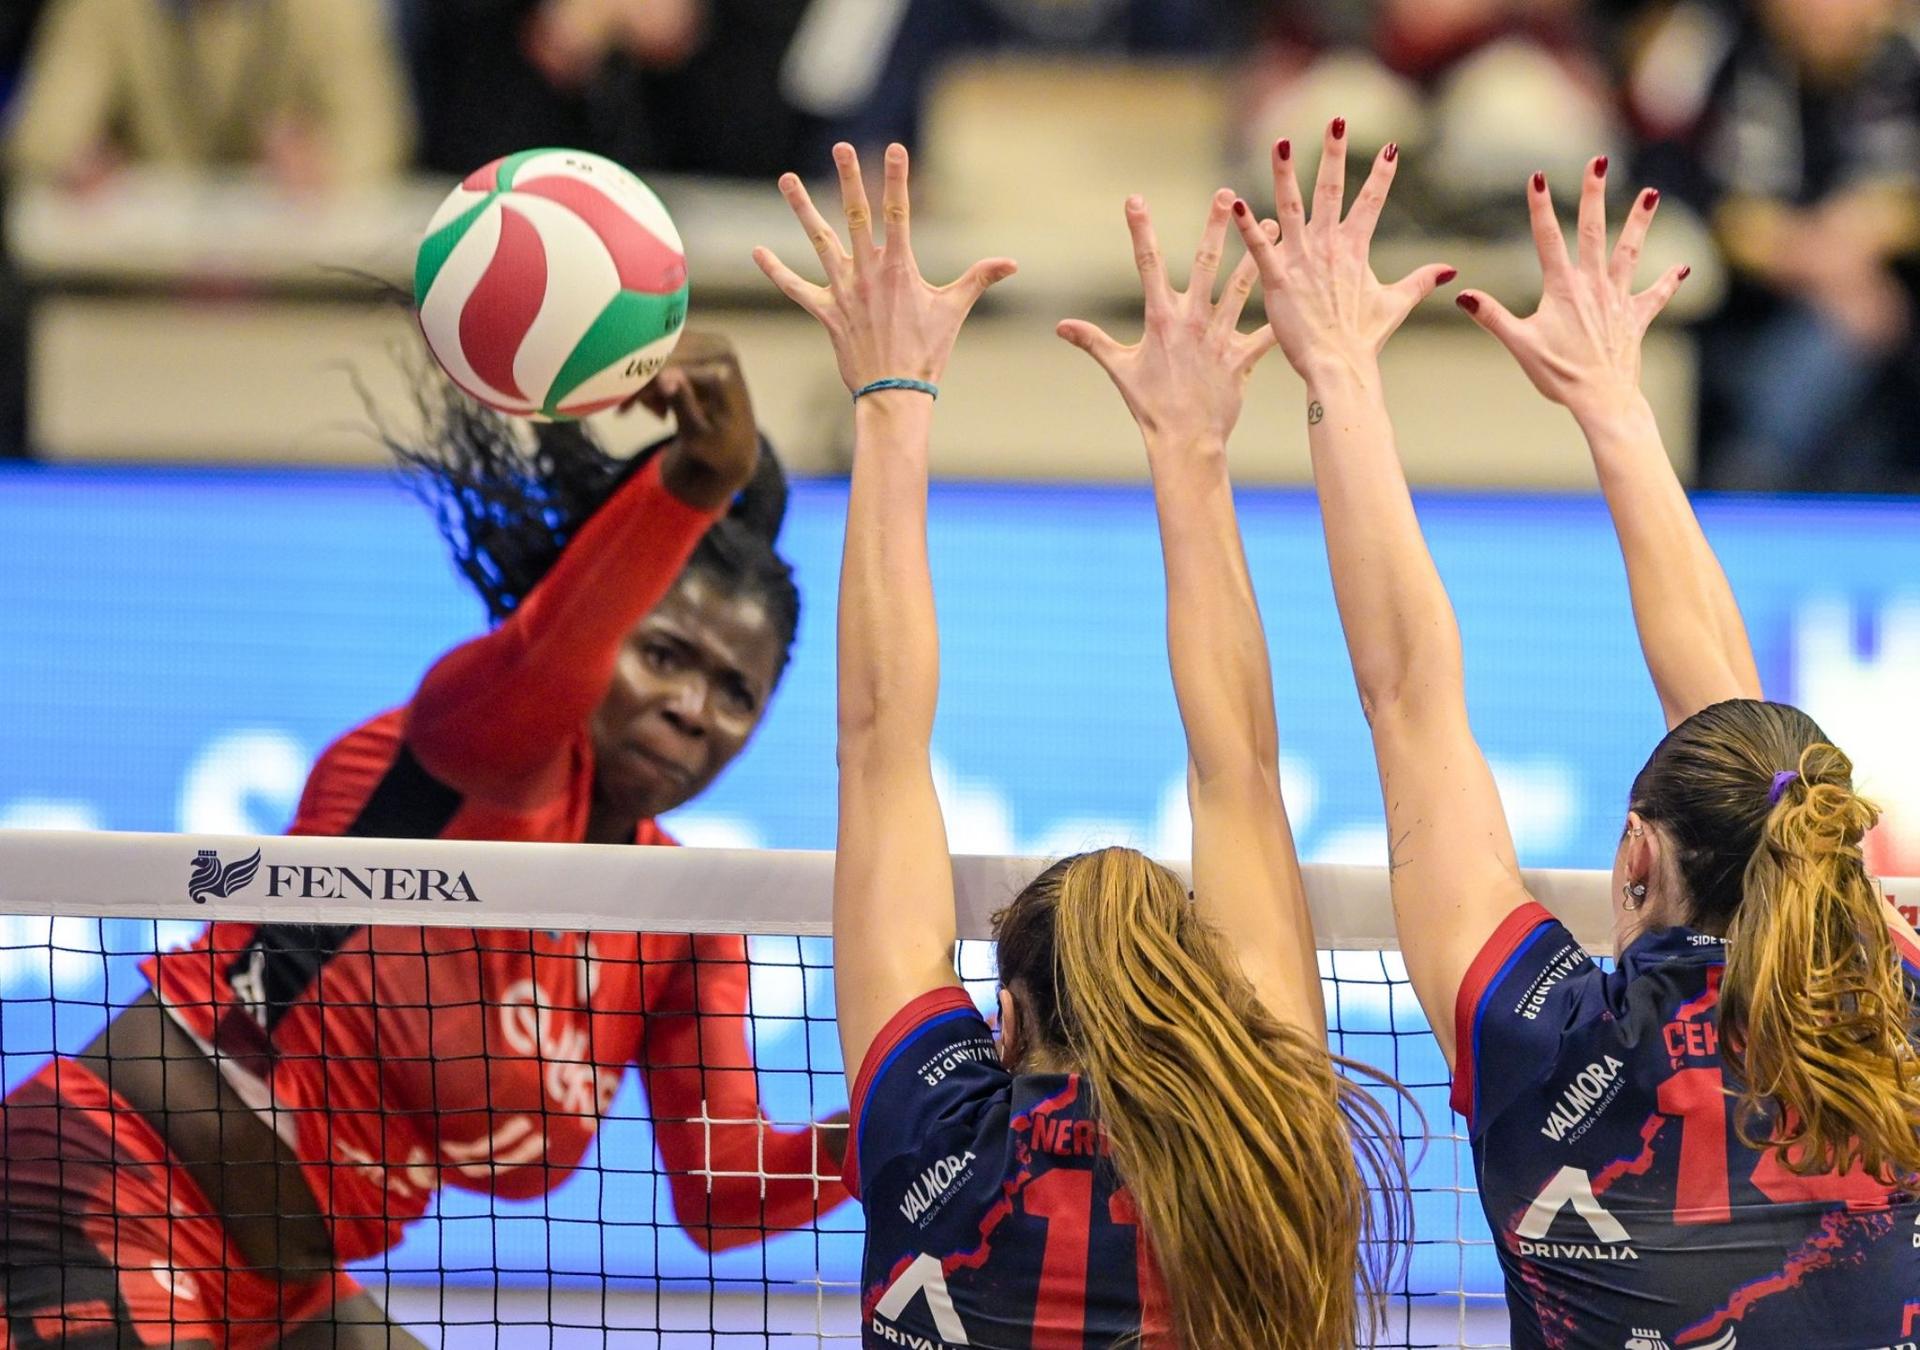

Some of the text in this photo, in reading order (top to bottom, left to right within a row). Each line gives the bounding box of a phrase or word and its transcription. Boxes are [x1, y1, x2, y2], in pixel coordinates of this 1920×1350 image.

[265, 865, 483, 903] FENERA
[1541, 1054, 1625, 1142] VALMORA
[1567, 1076, 1626, 1145] ACQUA MINERALE
[899, 1150, 977, 1224] VALMORA
[1518, 1240, 1639, 1260] DRIVALIA
